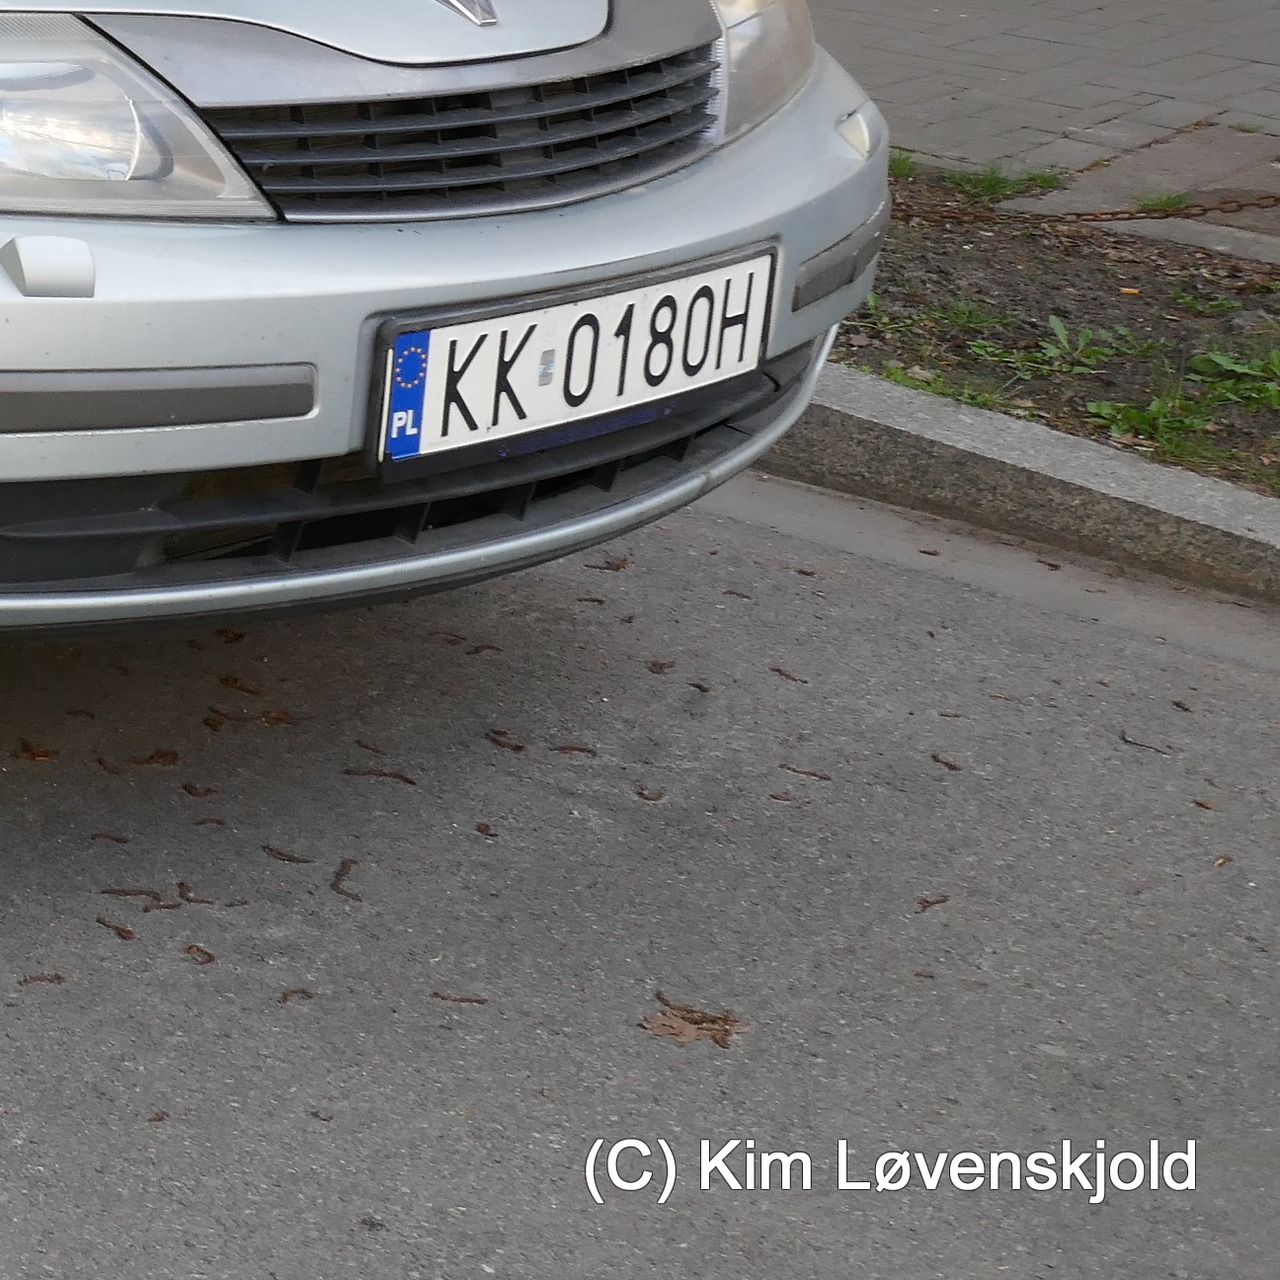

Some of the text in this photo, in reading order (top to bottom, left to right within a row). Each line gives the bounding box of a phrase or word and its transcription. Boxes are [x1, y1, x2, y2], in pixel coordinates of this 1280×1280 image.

[441, 272, 755, 437] KK 0180H
[391, 409, 419, 439] PL
